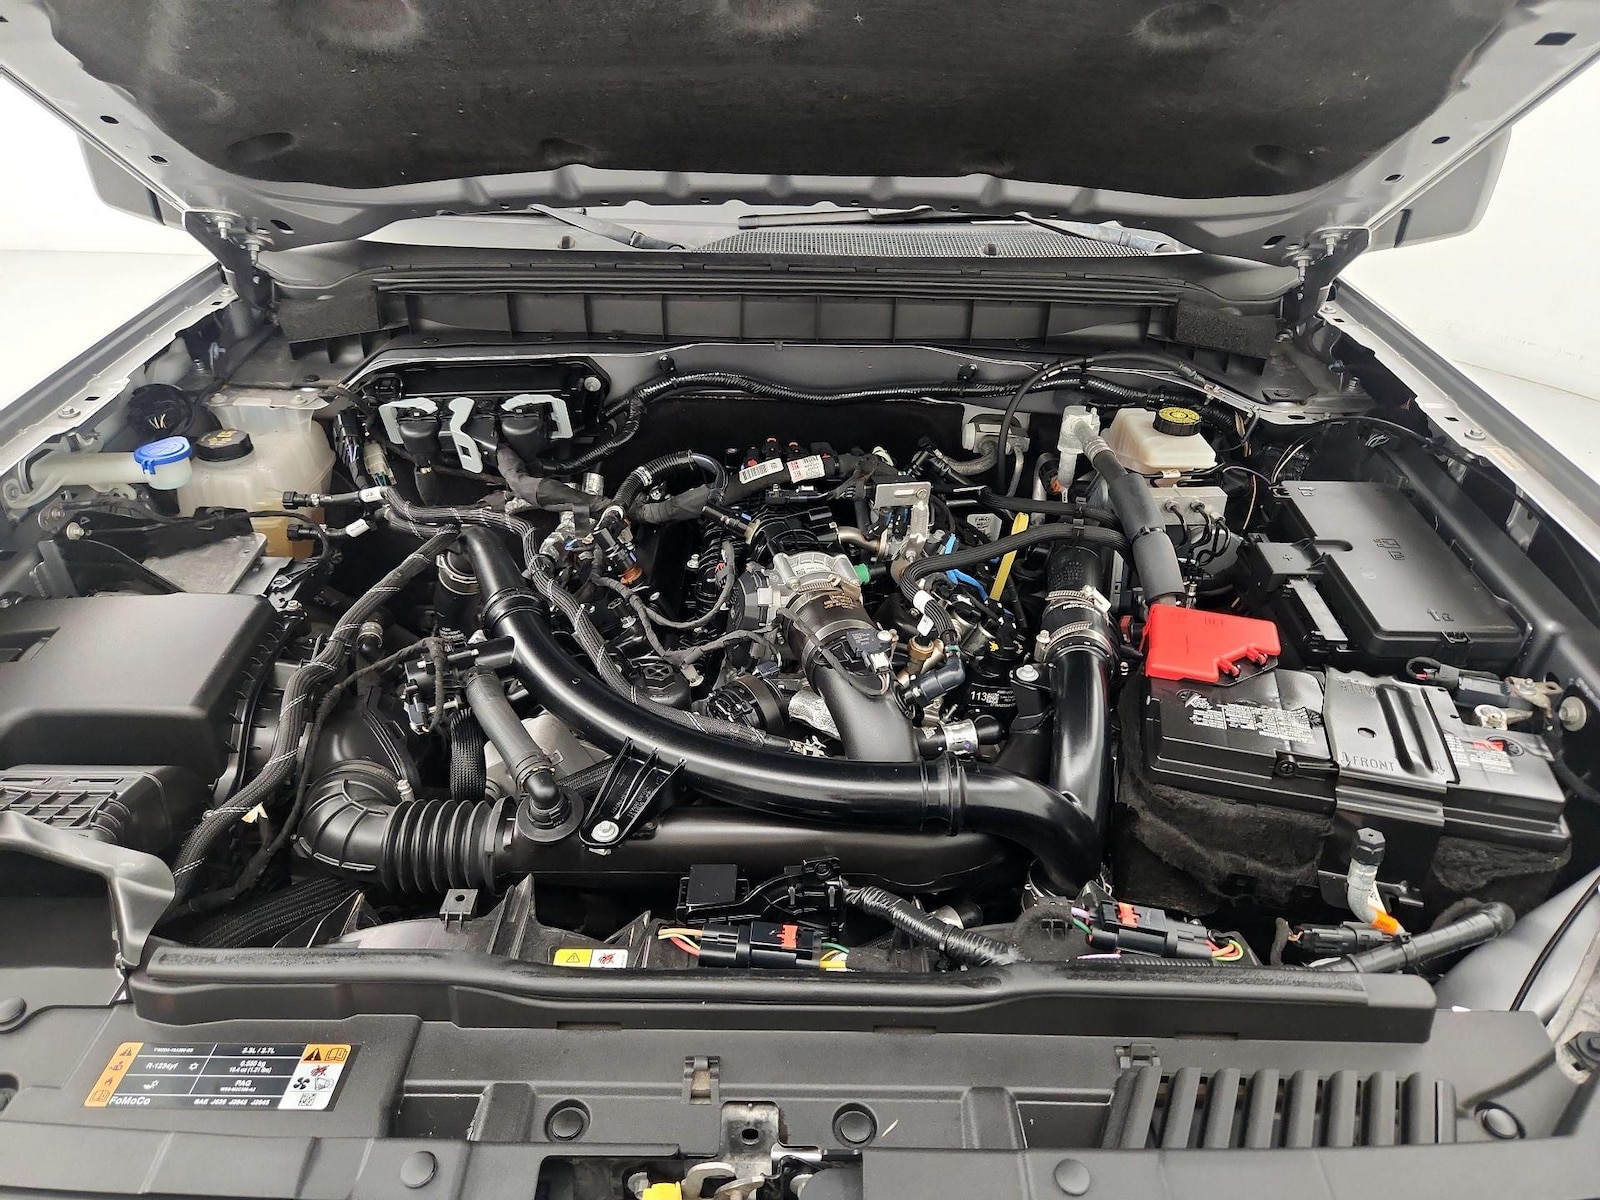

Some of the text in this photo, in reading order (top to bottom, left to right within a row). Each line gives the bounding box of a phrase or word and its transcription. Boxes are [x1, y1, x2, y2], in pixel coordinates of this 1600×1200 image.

[970, 690, 987, 702] 113
[1353, 755, 1394, 772] FRONT
[145, 1062, 179, 1071] R-1234yf
[109, 1096, 151, 1105] FoMoCo
